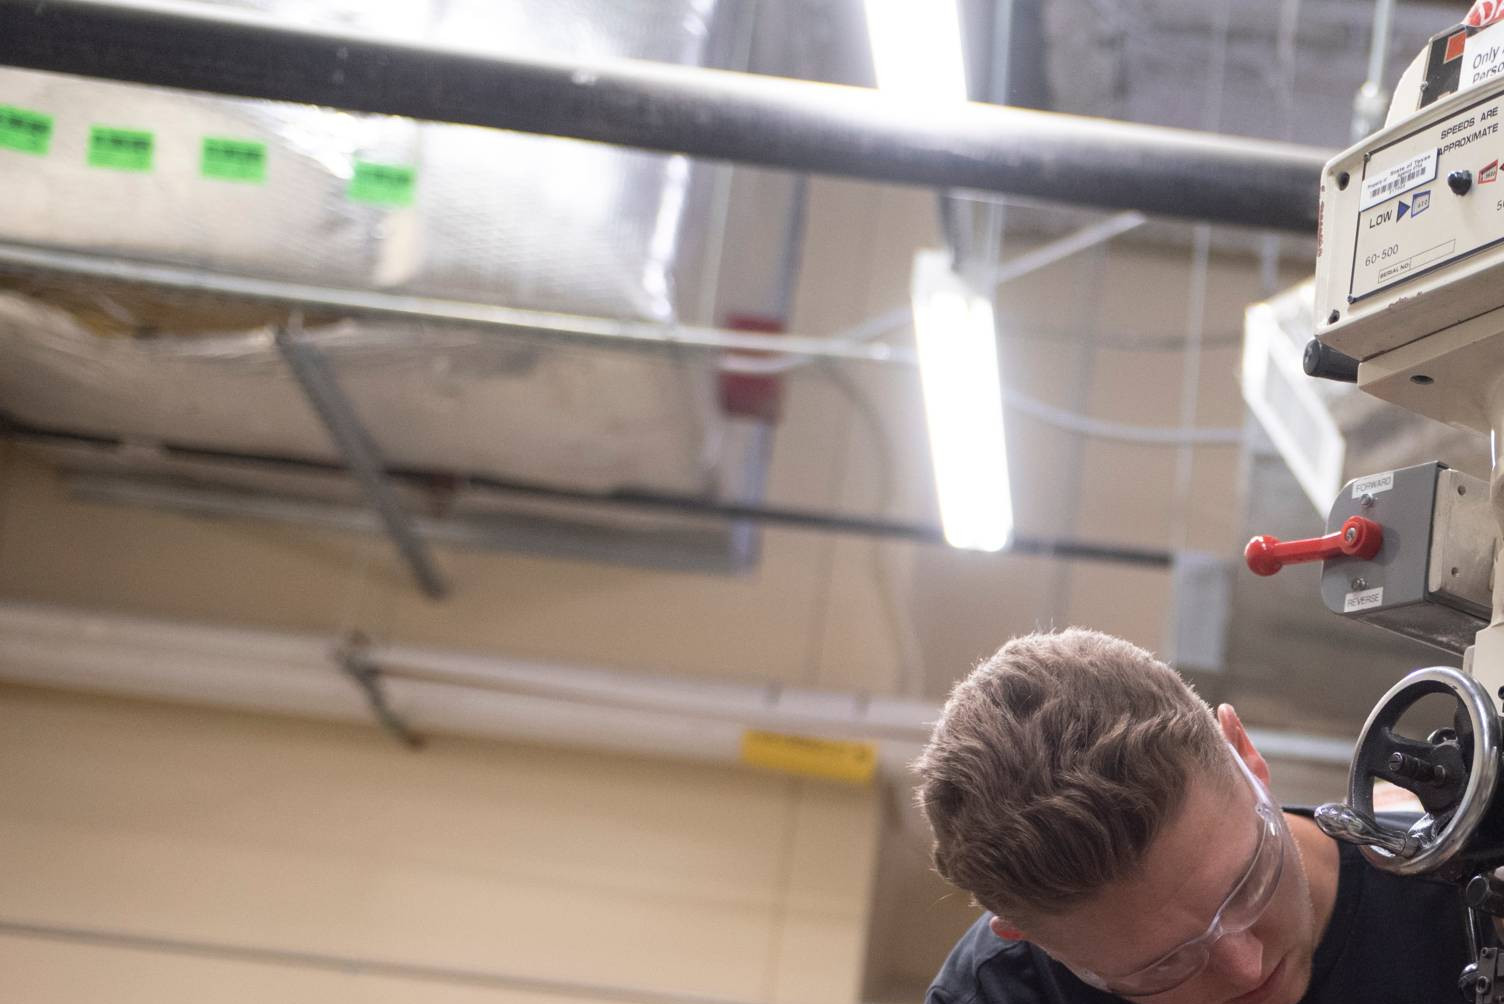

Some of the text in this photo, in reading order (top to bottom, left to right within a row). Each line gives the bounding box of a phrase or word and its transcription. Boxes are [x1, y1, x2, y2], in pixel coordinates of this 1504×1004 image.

[1472, 46, 1501, 69] Only
[1440, 106, 1499, 140] SPEEDS ARE
[1437, 122, 1499, 156] APPROXIMATE
[1369, 209, 1393, 229] LOW
[1364, 244, 1400, 267] 60-500
[1379, 264, 1400, 280] SERIAL
[1356, 477, 1391, 491] FORWARD
[1348, 593, 1379, 606] REVERSE
